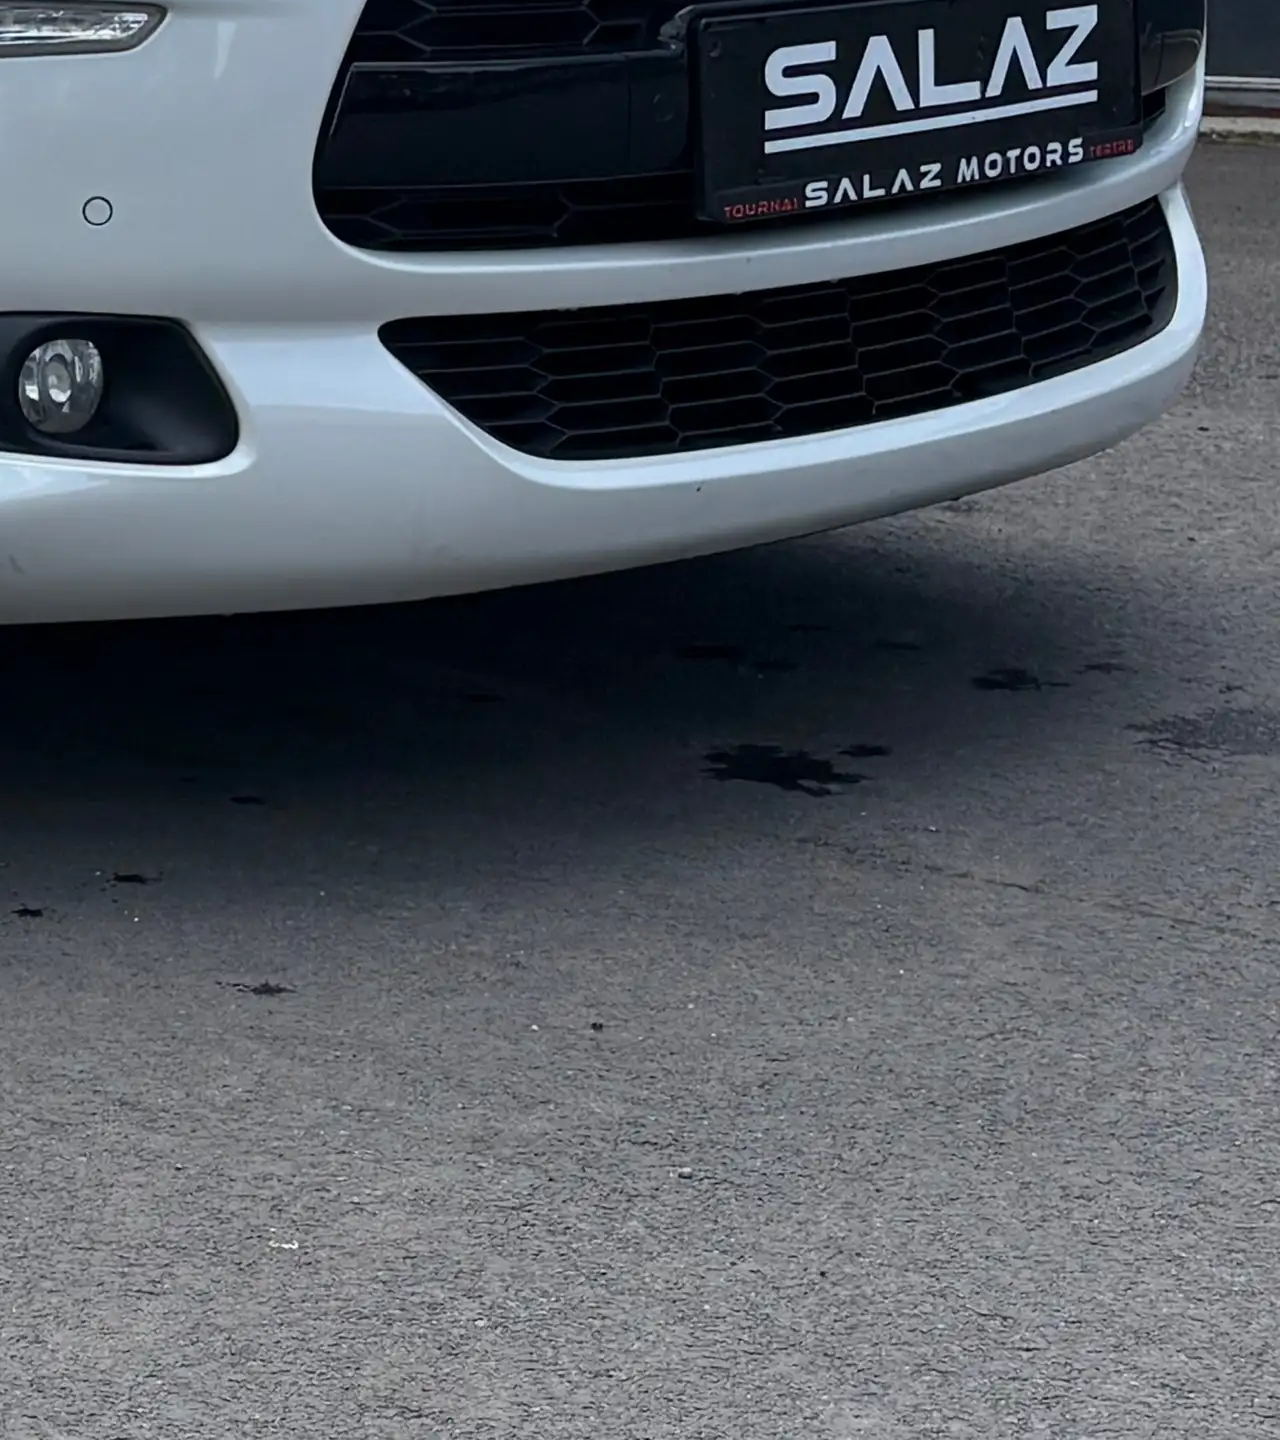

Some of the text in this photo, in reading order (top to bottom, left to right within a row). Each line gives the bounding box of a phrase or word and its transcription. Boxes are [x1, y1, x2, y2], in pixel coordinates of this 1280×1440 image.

[764, 4, 1098, 130] SALAZ
[724, 197, 799, 219] TOURNAI
[804, 162, 943, 208] SALAZ
[955, 137, 1085, 184] MOTORS
